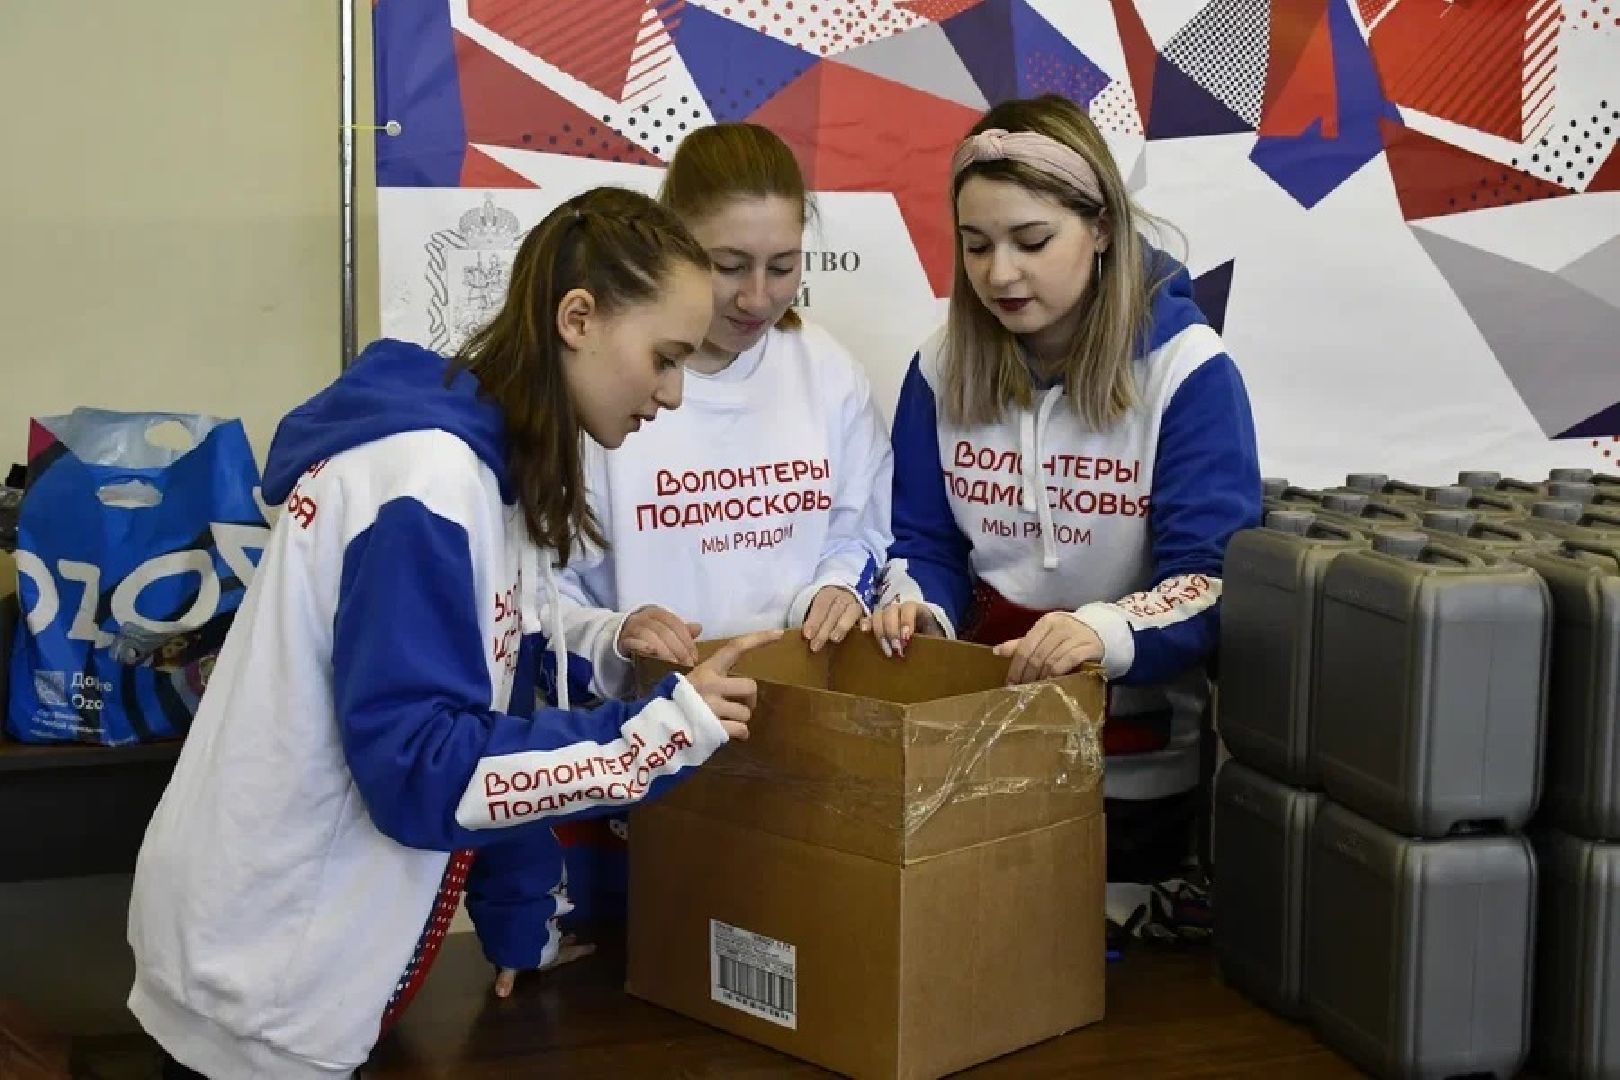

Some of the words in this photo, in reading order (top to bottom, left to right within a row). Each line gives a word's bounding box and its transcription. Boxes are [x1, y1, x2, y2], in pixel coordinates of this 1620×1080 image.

[656, 458, 830, 497] ВОЛОНТЕРЫ
[954, 440, 1140, 483] ВОЛНТЕРЫ
[702, 533, 730, 555] МЫ
[733, 522, 794, 550] РЯДОМ
[981, 517, 1018, 537] МЫ
[485, 732, 647, 798] ВОЛОНТЕРЫ
[488, 730, 693, 821] ПОДМОСКОВЬЯ
